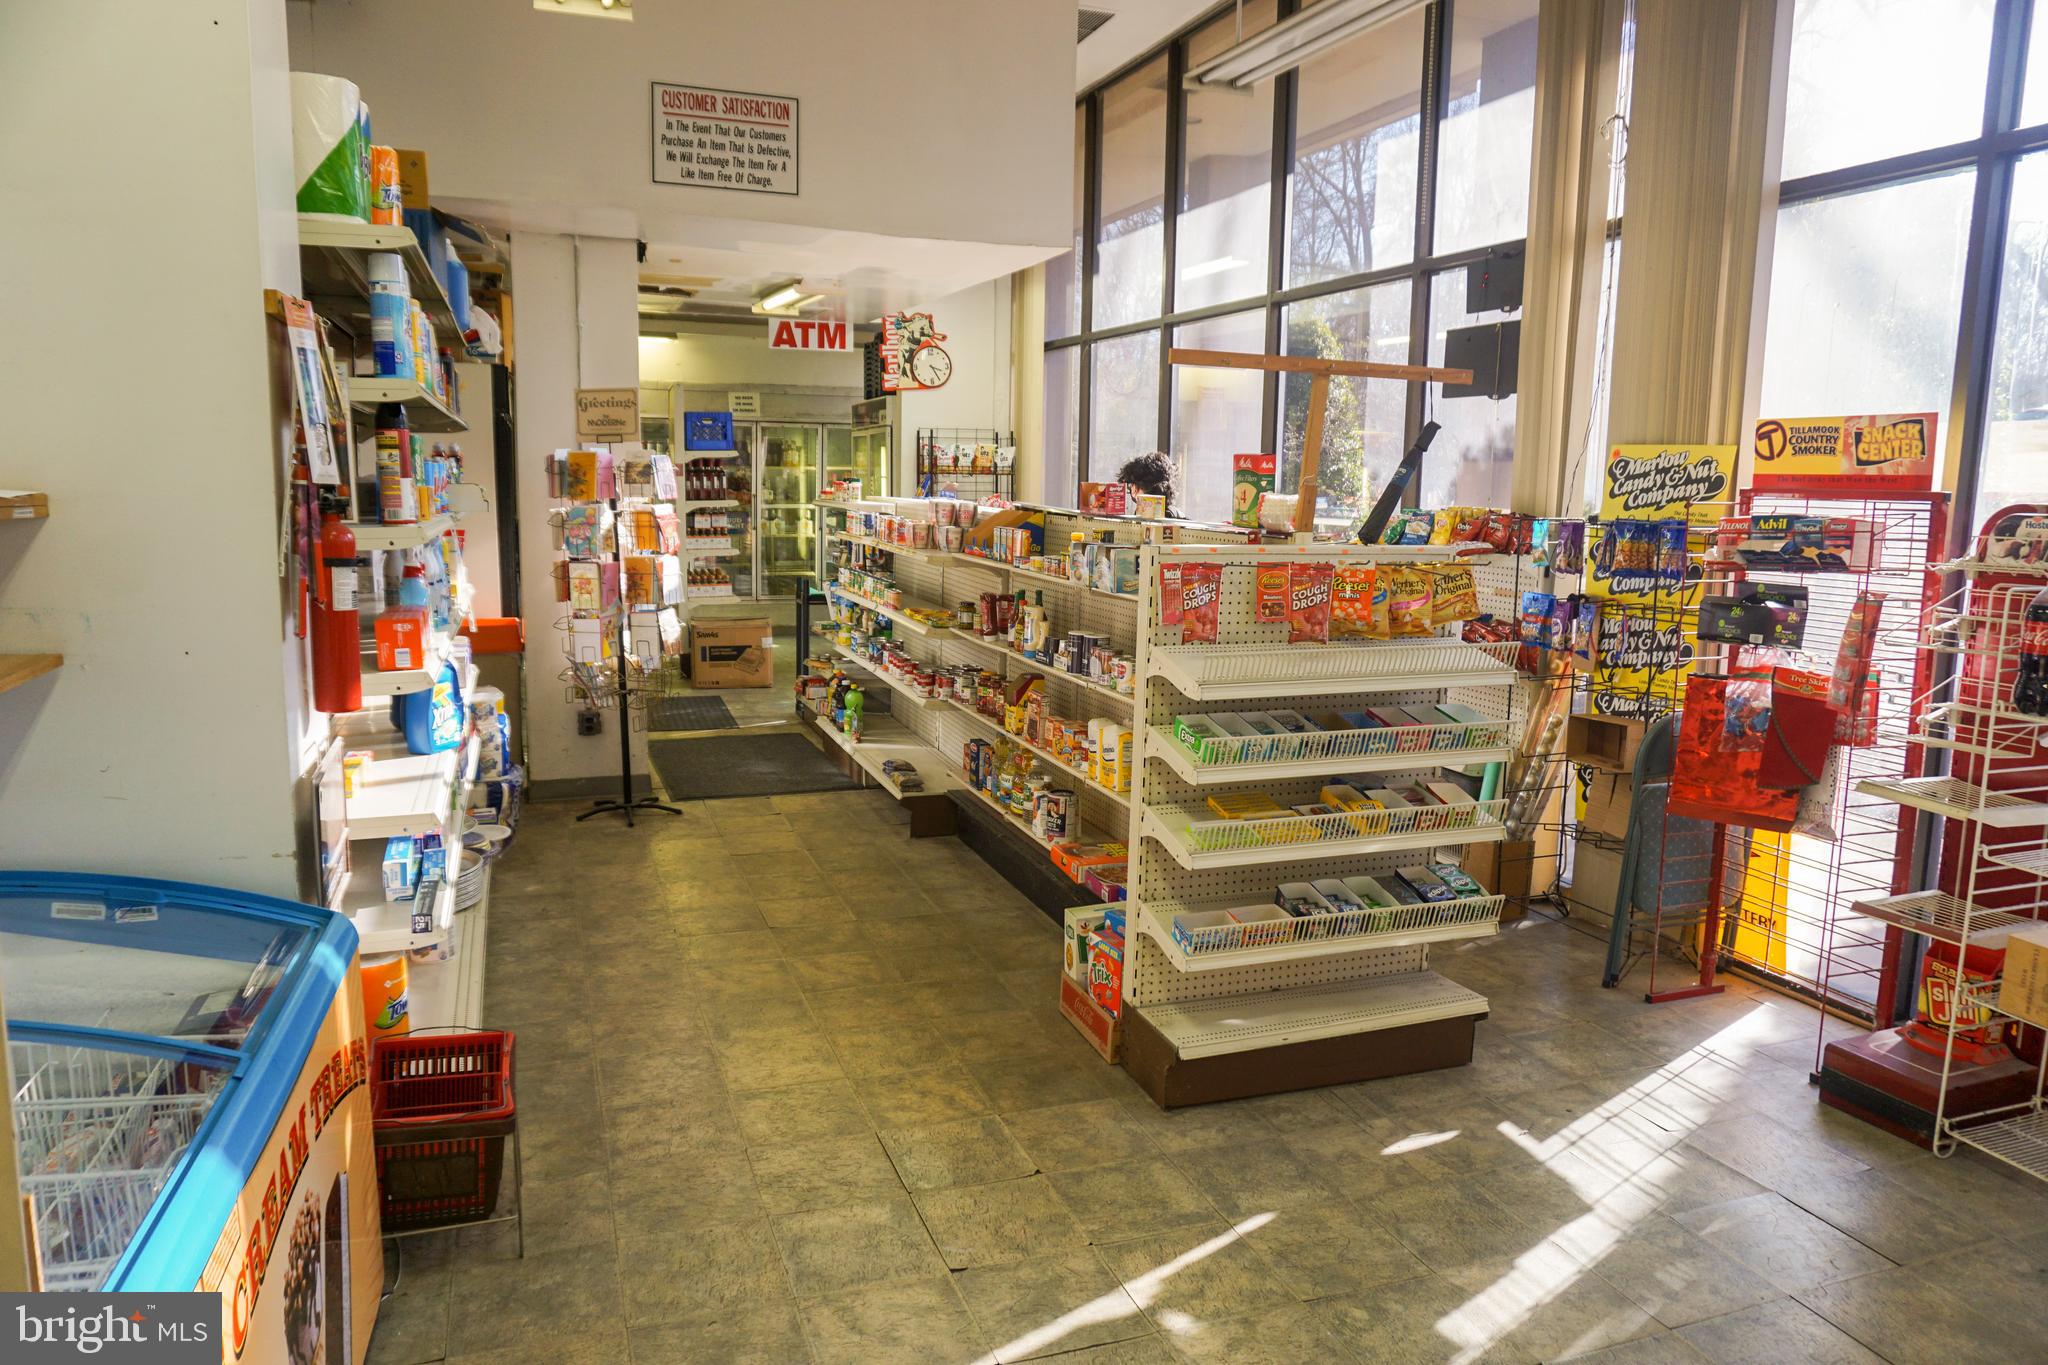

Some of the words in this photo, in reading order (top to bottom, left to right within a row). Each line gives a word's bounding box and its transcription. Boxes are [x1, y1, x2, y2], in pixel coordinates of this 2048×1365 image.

[661, 89, 717, 113] CUSTOMER
[722, 97, 790, 120] SATISFACTION
[666, 118, 673, 131] In
[676, 119, 689, 132] The
[692, 121, 712, 134] Event
[715, 124, 730, 136] That
[734, 126, 746, 137] Our
[749, 127, 786, 142] Customers
[661, 134, 694, 148] Purchase
[697, 137, 707, 149] An
[710, 138, 726, 151] Item
[729, 140, 744, 153] That
[748, 142, 754, 154] Is
[757, 143, 791, 159] Defective,
[666, 150, 676, 161] We
[679, 151, 693, 163] Will
[696, 153, 730, 168] Exchange
[732, 156, 745, 168] The
[748, 157, 764, 170] Item
[767, 159, 778, 172] For
[781, 160, 786, 172] A
[680, 166, 695, 179] Like
[698, 168, 714, 181] Item
[717, 169, 732, 182] Free
[735, 171, 744, 184] Of
[747, 173, 773, 187] Charge.
[773, 321, 846, 349] ATM
[579, 396, 637, 412] Greetings
[1788, 434, 1840, 446] COUNTRY
[1789, 426, 1840, 435] TILLAMOOK
[1861, 423, 1922, 442] SNACK
[1791, 445, 1837, 456] SMOKER
[1856, 439, 1923, 461] CENTER
[1612, 450, 1690, 478] Marlow
[1613, 470, 1664, 495] Candy
[1665, 467, 1684, 486] &
[1678, 456, 1719, 484] Nut
[1628, 472, 1727, 507] Company
[1756, 518, 1787, 530] Advil
[1183, 582, 1216, 600] COUGH
[1292, 583, 1328, 600] COUGH
[1338, 591, 1360, 599] minis
[1435, 581, 1473, 595] Original
[1184, 591, 1216, 610] DROPS
[1292, 592, 1328, 611] DROPS
[1639, 632, 1652, 650] &
[1791, 674, 1808, 683] Tree
[415, 915, 425, 929] 25
[1092, 962, 1113, 987] Trix
[233, 1103, 309, 1360] CREAM
[310, 1037, 367, 1142] TREATS
